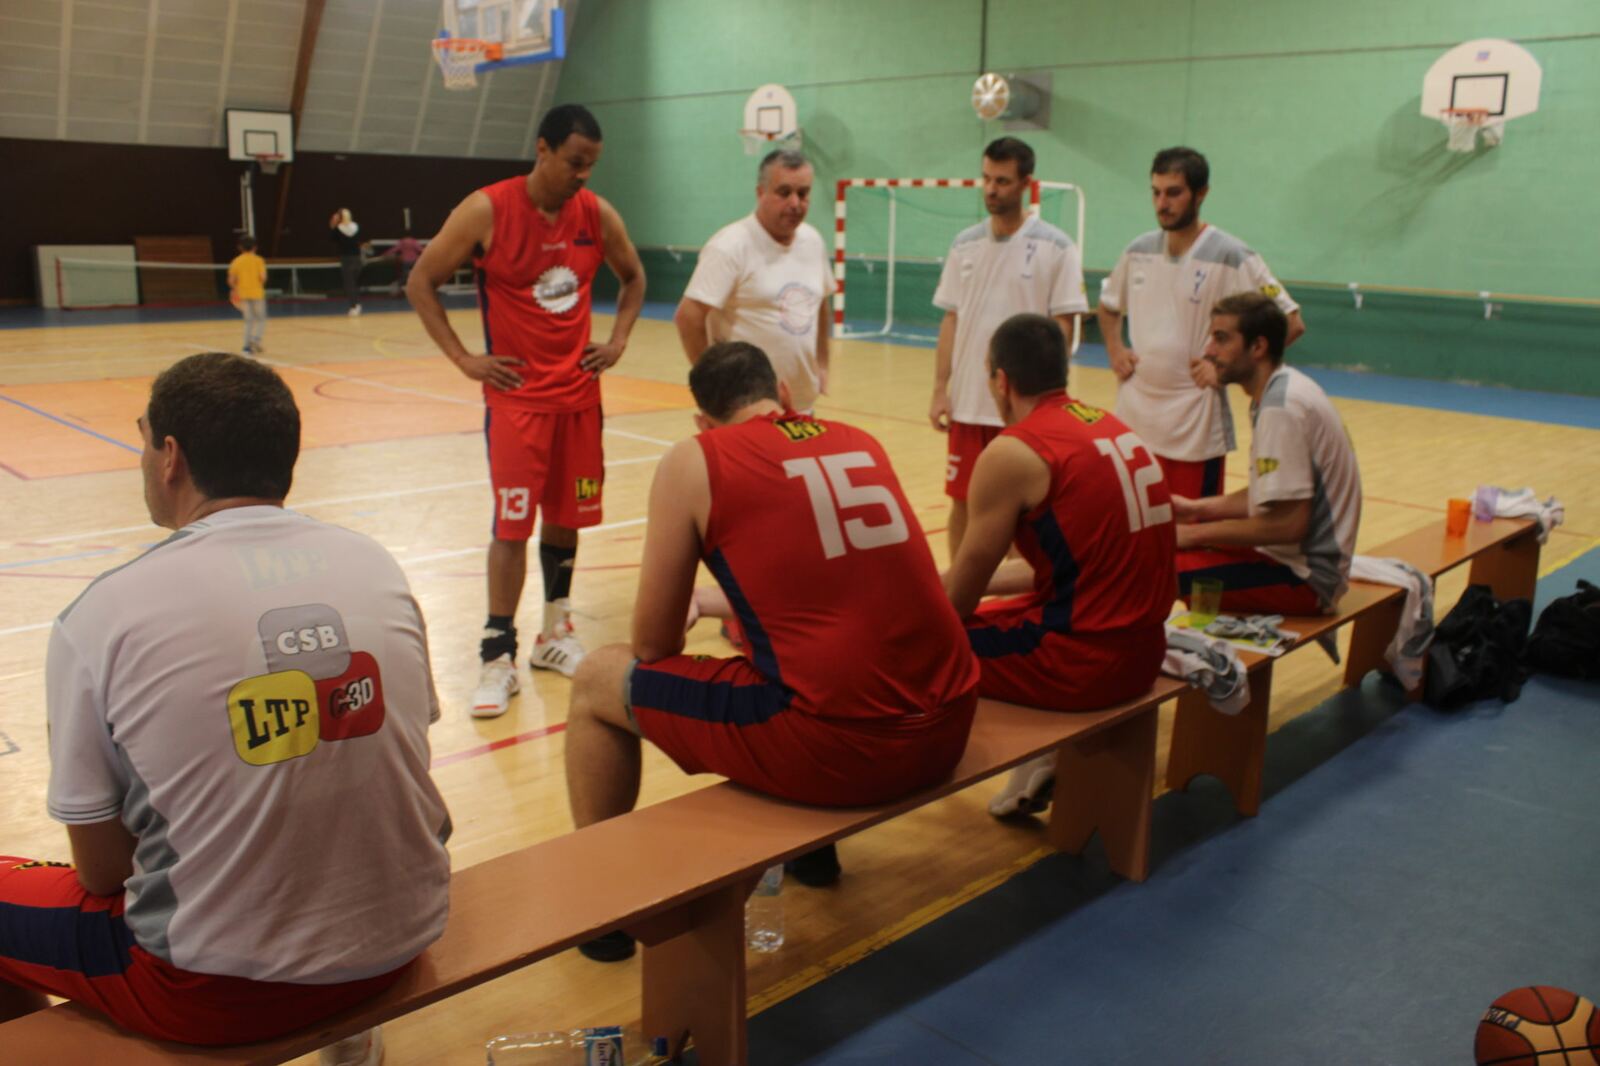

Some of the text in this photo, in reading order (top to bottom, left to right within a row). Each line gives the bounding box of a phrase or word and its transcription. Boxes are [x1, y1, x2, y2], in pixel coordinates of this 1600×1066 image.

[498, 487, 530, 520] 13
[782, 451, 910, 560] 15
[1093, 431, 1173, 533] 12
[276, 624, 339, 655] CSB
[239, 698, 310, 751] LTP
